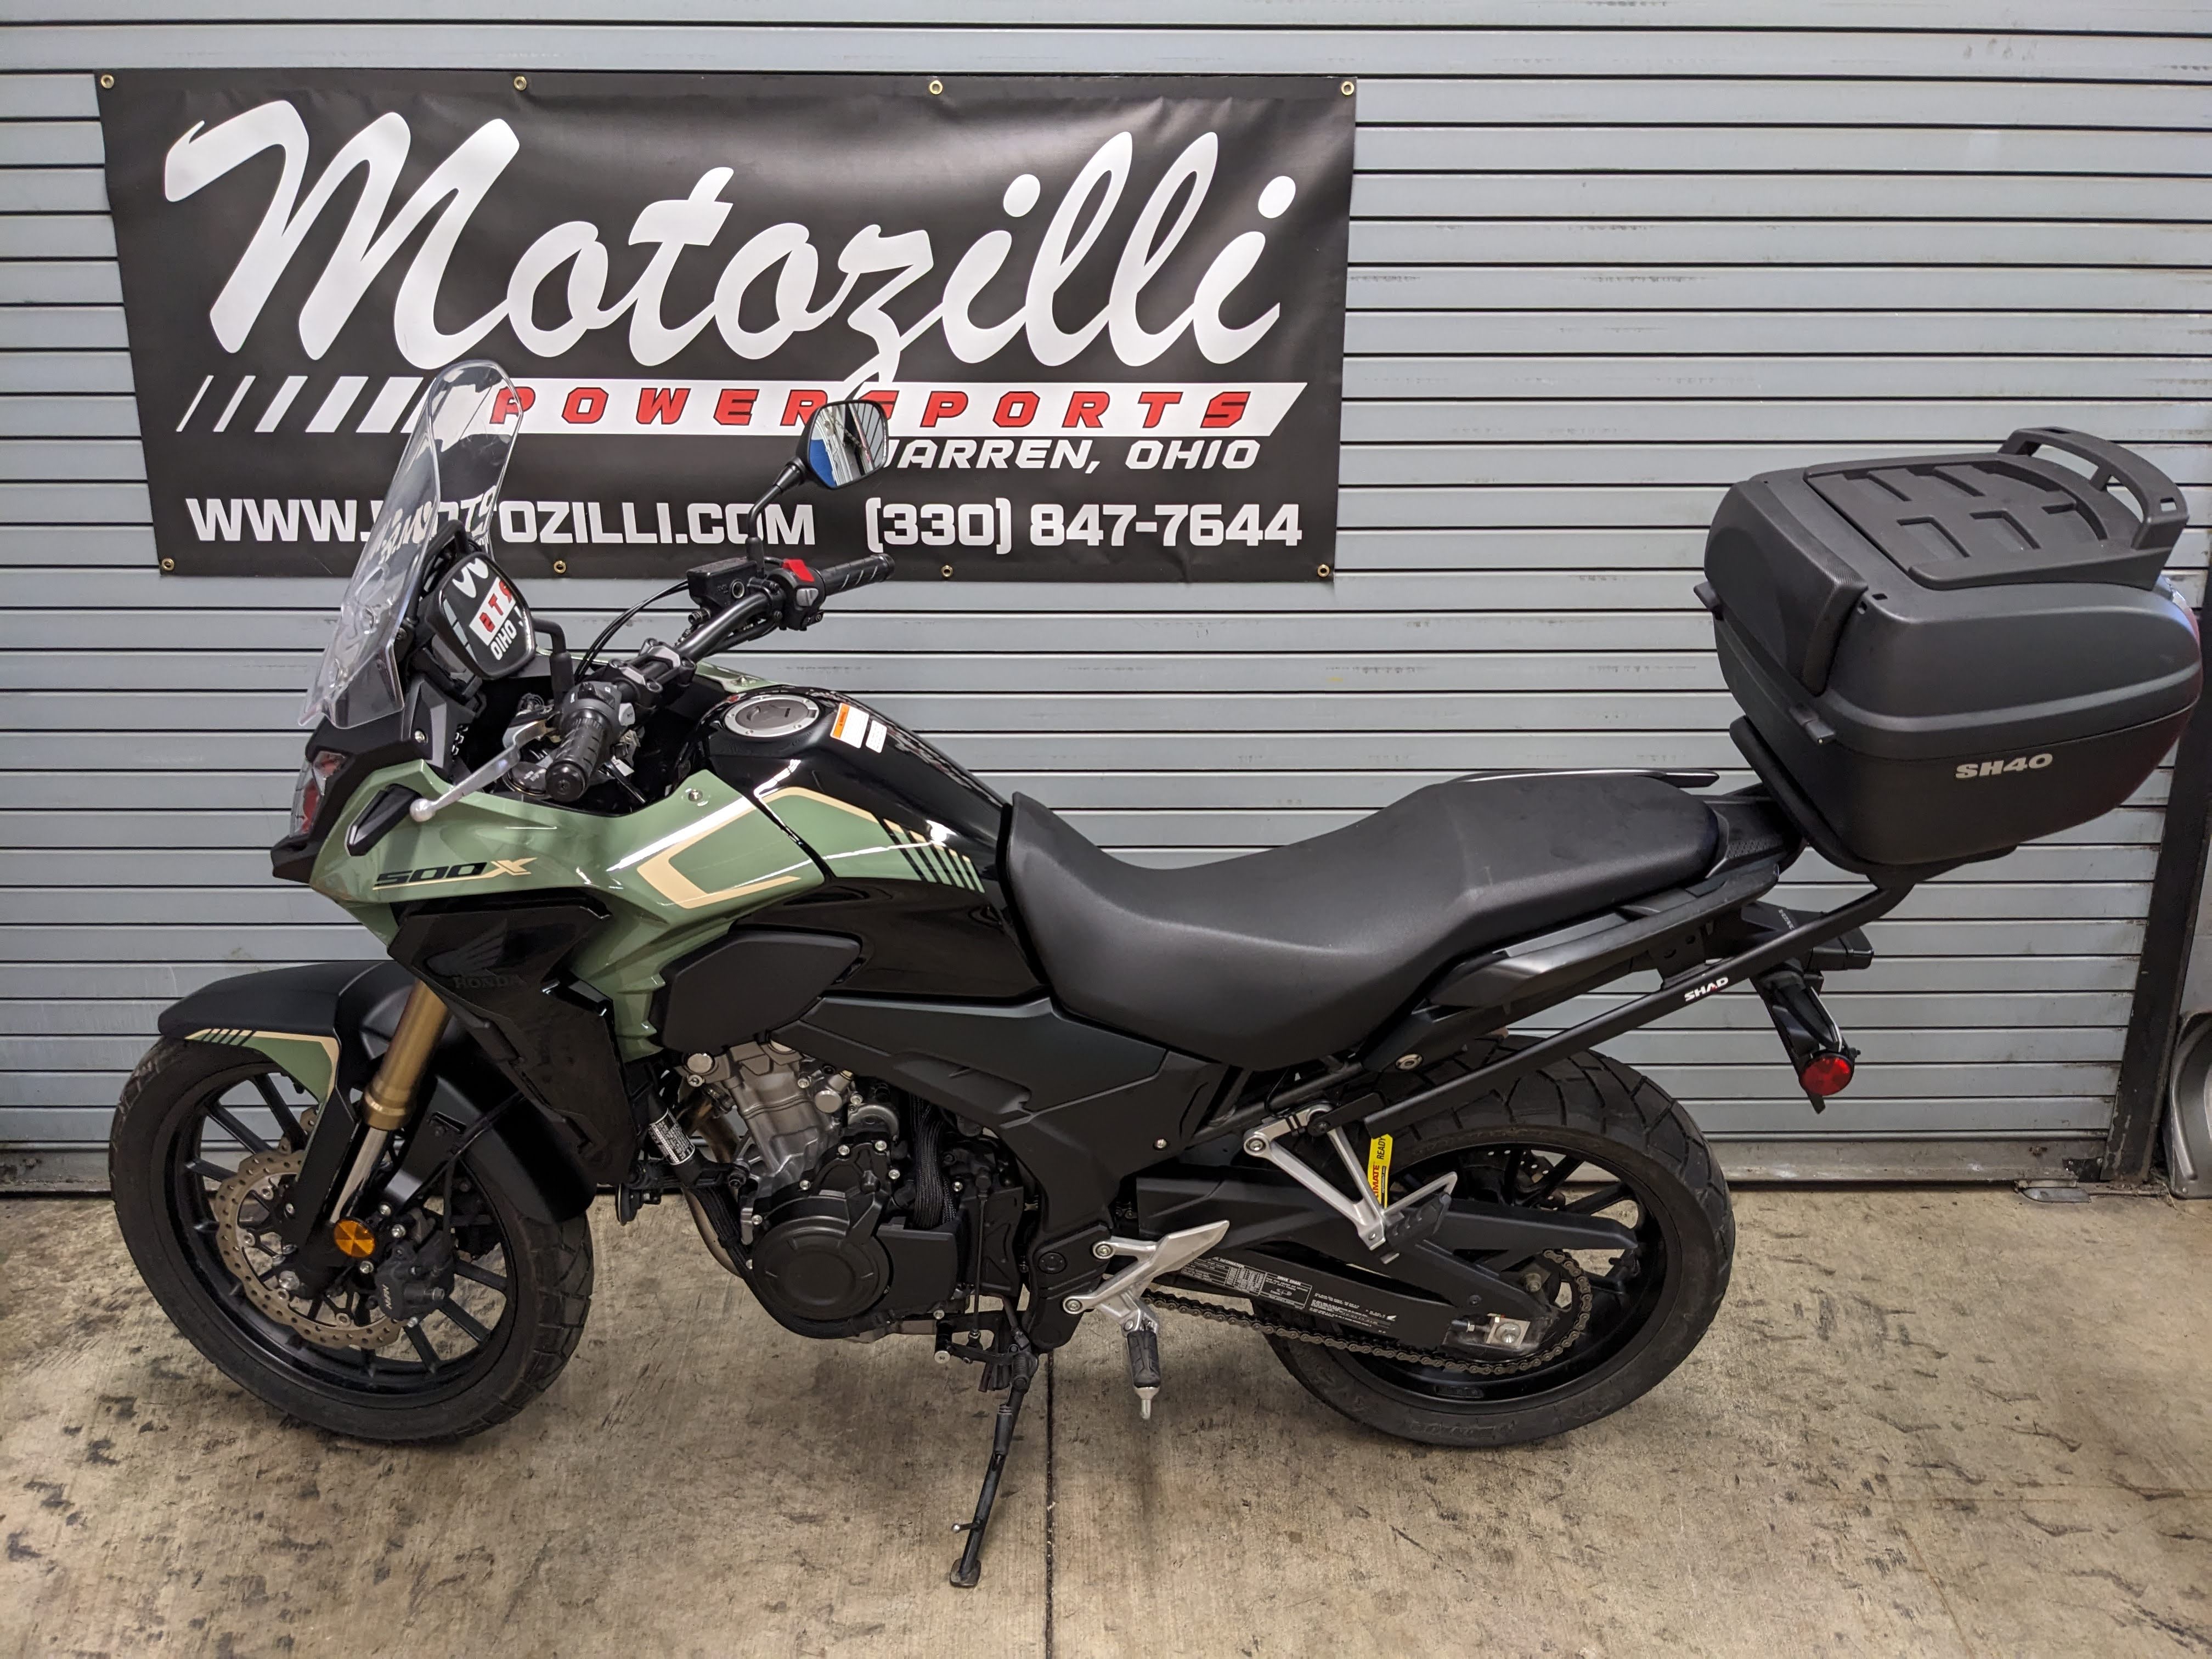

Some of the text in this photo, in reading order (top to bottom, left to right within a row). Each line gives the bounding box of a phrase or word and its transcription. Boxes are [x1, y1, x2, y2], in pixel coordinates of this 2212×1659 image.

[165, 99, 1295, 396] Motozilli
[867, 439, 1261, 474] ARREN, OHIO
[865, 497, 1012, 555] (330)
[1030, 504, 1302, 546] 847-7644
[1955, 753, 2053, 778] SH40
[374, 857, 538, 890] 500X
[453, 975, 525, 989] HONDA
[1684, 977, 1729, 1002] SHAD
[1376, 1137, 1386, 1160] READY
